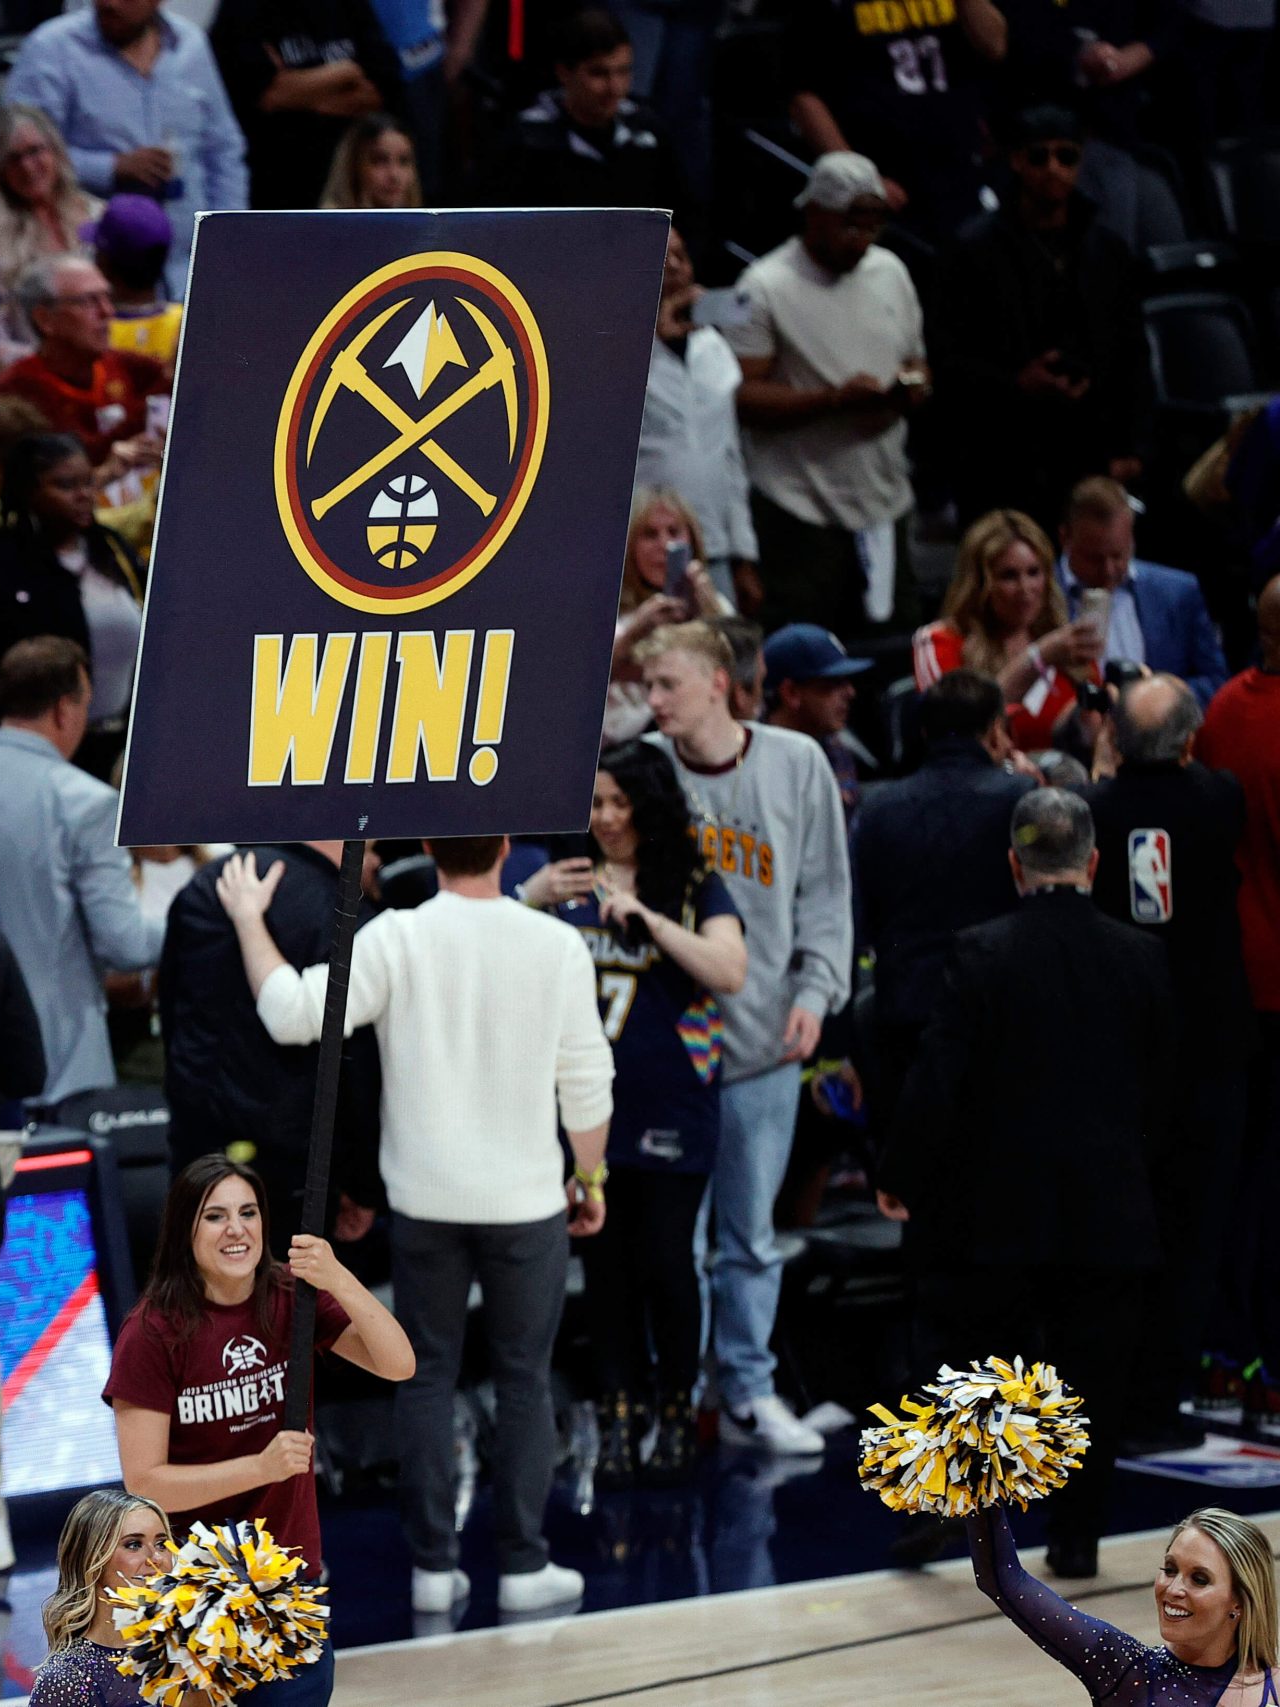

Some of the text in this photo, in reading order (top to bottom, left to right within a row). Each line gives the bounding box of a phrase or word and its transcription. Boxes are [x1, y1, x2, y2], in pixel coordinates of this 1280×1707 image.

[248, 629, 515, 786] WIN!
[689, 825, 774, 887] GETS
[598, 970, 638, 1042] 7
[177, 1382, 260, 1424] BRING
